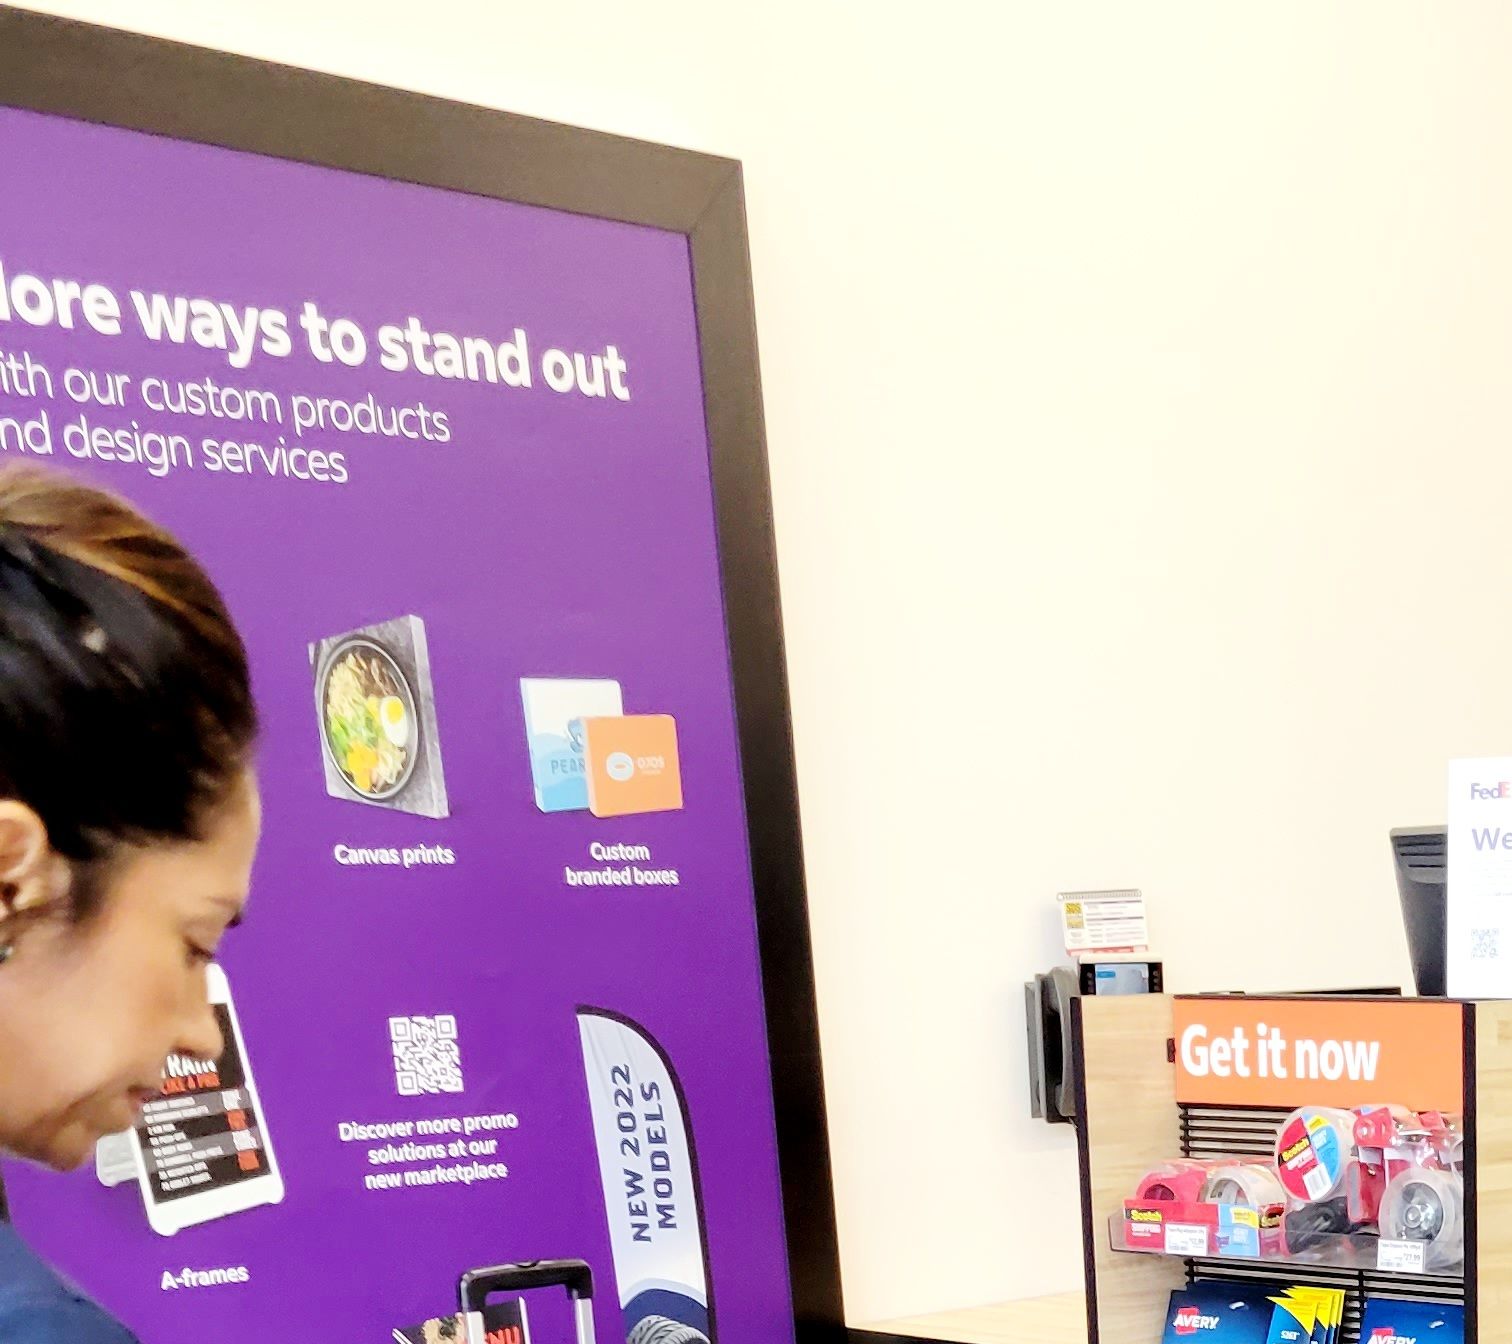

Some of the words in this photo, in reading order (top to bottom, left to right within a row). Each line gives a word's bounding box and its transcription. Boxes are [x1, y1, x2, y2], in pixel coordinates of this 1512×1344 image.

[129, 289, 292, 369] ways
[300, 300, 367, 367] to
[378, 315, 532, 388] stand
[542, 344, 631, 402] out
[0, 350, 54, 399] ith
[63, 367, 131, 407] our
[141, 376, 282, 426] custom
[291, 391, 451, 443] products
[0, 409, 54, 455] nd
[63, 413, 193, 477] design
[202, 436, 348, 484] services
[334, 844, 401, 865] Canvas
[402, 843, 456, 869] prints
[589, 841, 651, 861] Custom
[565, 866, 633, 887] branded
[633, 867, 680, 886] boxes
[1180, 1023, 1251, 1079] Get
[1257, 1022, 1288, 1079] it
[1294, 1035, 1381, 1081] now
[611, 1063, 640, 1158] 2022
[338, 1117, 415, 1142] Discover
[416, 1118, 461, 1137] more
[463, 1112, 519, 1136] promo
[367, 1142, 447, 1165] solutions
[448, 1140, 468, 1159] at
[469, 1139, 498, 1156] our
[640, 1081, 677, 1230] MODELS
[364, 1172, 402, 1190] new
[403, 1160, 508, 1186] marketplace
[620, 1168, 652, 1242] NEW
[160, 1265, 250, 1290] A-frames
[1173, 1313, 1220, 1330] AVERY
